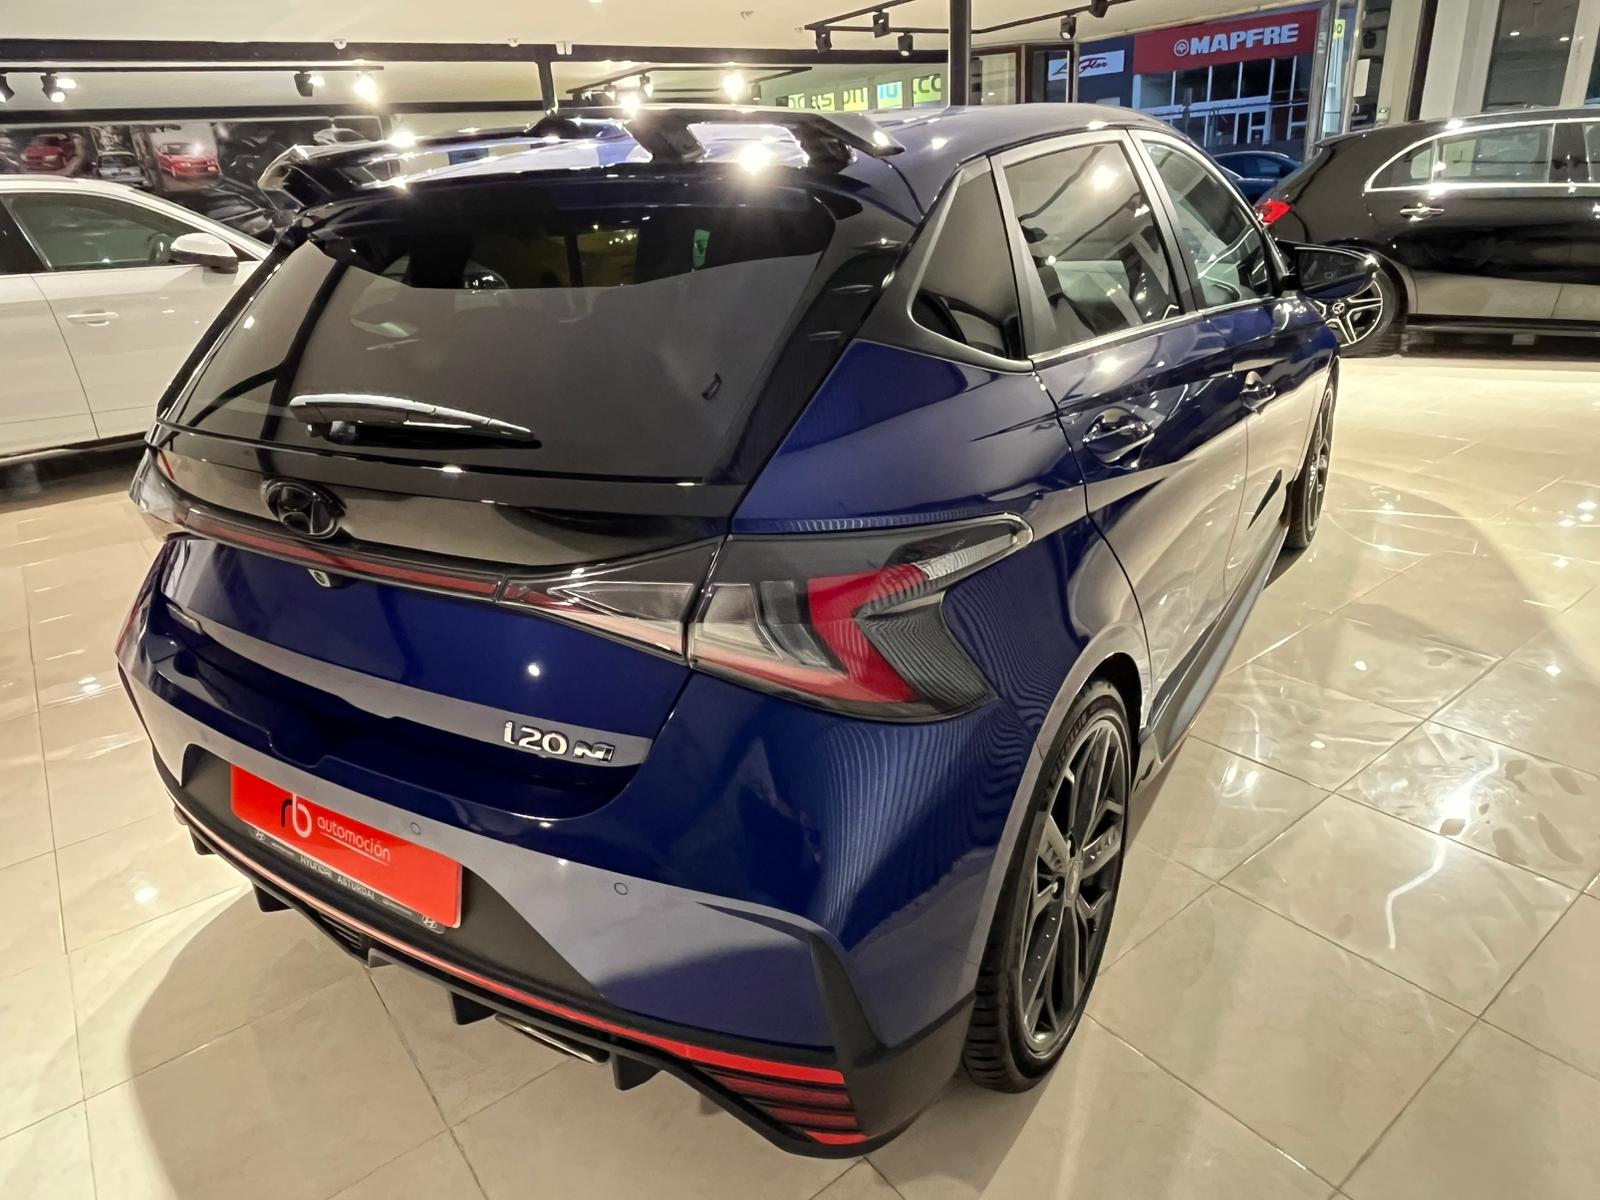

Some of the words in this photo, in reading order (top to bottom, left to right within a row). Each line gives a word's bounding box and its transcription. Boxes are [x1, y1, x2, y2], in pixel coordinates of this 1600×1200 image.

[1189, 23, 1300, 56] MAPFRE
[503, 720, 569, 756] i20
[316, 816, 391, 863] automoción
